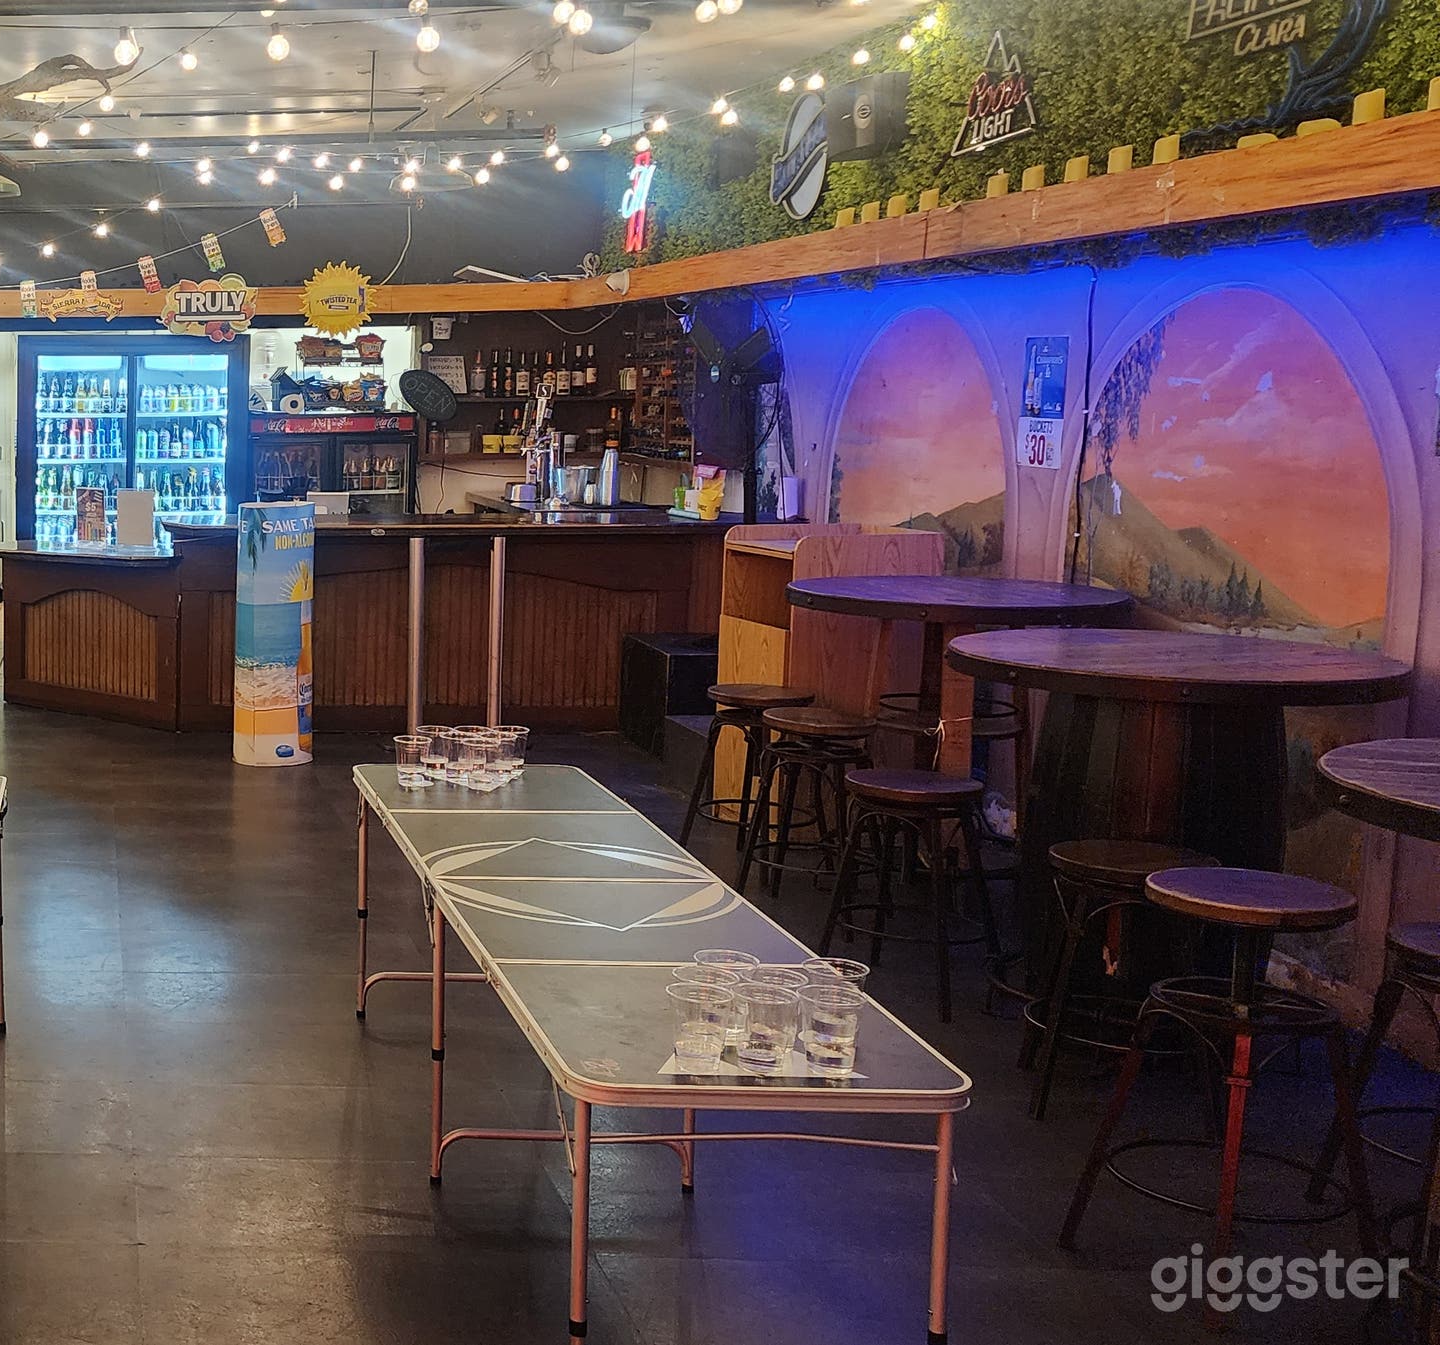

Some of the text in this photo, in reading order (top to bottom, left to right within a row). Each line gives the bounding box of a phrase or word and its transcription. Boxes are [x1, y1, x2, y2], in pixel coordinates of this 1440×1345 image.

[1234, 13, 1306, 56] CLARA
[967, 72, 1028, 120] Coors
[970, 108, 1014, 144] LIGHT
[52, 299, 80, 310] SIERRA
[175, 291, 246, 313] TRULY
[320, 296, 358, 306] TWISTED TEA
[1024, 433, 1046, 465] $30
[84, 501, 98, 511] $5
[261, 518, 300, 534] SAME
